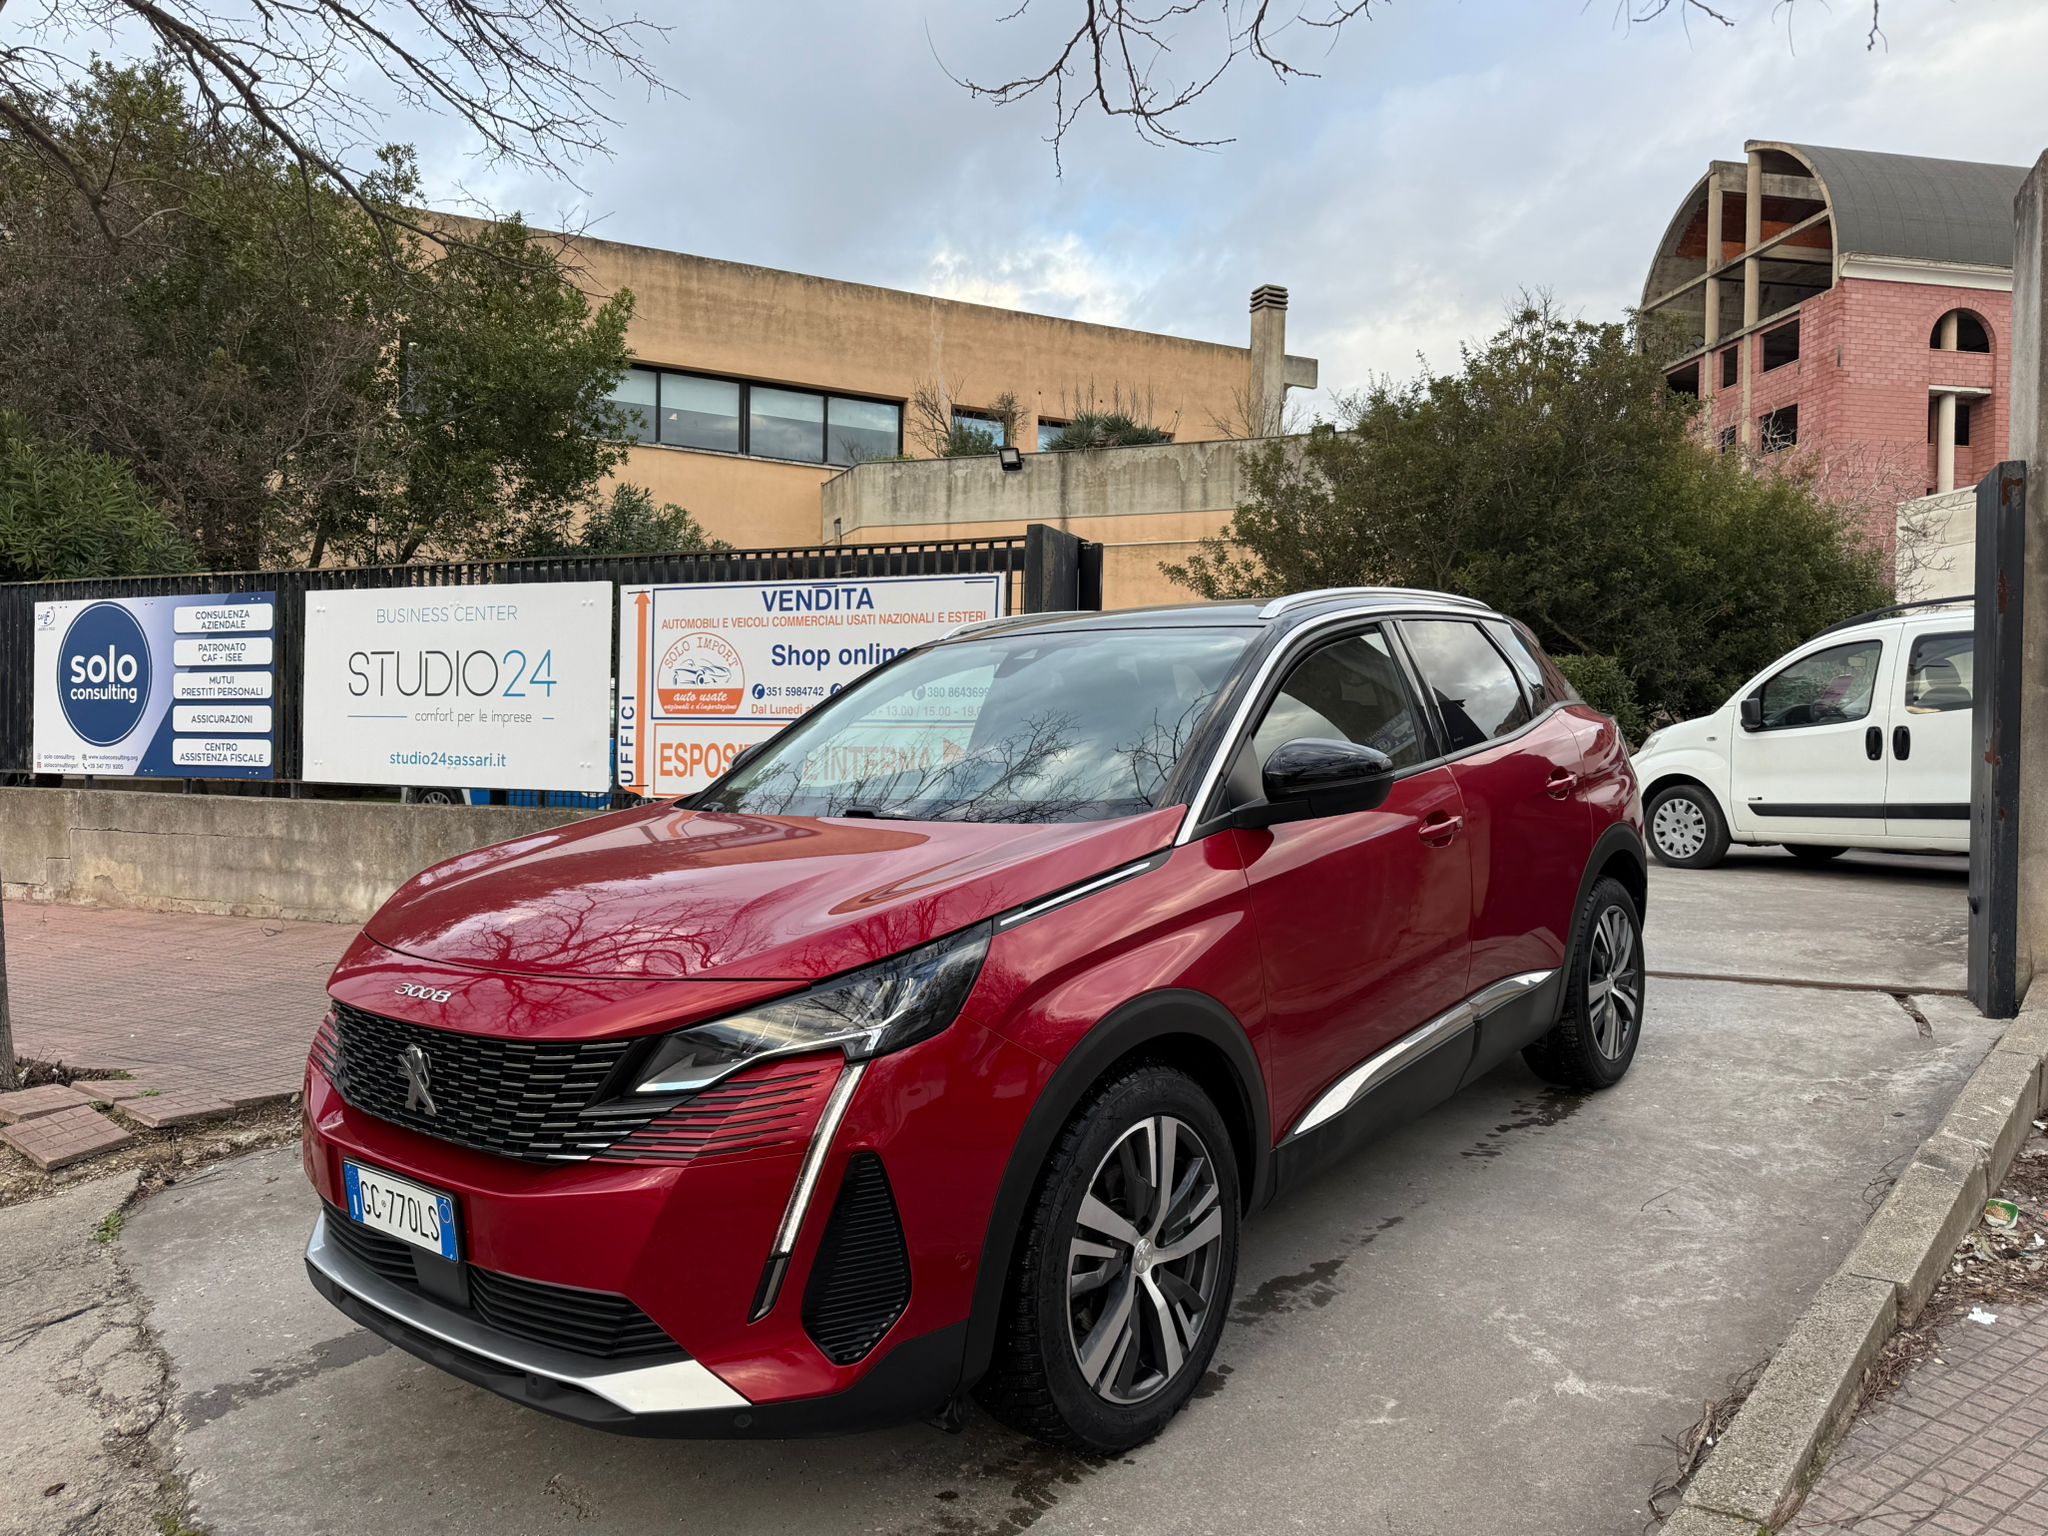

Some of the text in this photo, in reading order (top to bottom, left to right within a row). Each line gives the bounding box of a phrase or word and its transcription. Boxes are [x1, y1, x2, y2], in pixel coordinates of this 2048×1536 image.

[761, 587, 874, 612] VENDITA
[195, 609, 250, 620] CONSULENZA
[376, 604, 518, 624] BUSINESS CENTER
[661, 610, 986, 630] AUTOMOBILI E VEICOLI COMMERCIALI USATI NAZIONALI E ESTERI
[201, 620, 246, 630] AZIENDALE
[198, 643, 247, 653] PATRONATO
[664, 636, 738, 669] SOLO IMPORT
[201, 653, 218, 663] CAF
[225, 652, 243, 662] ISEE
[771, 643, 831, 671] Shop
[70, 644, 138, 683] solo
[348, 648, 557, 698] STUDIO24
[209, 675, 235, 685] MUTUI
[70, 683, 138, 704] consulting
[181, 687, 264, 697] PRESTITI PERSONALI
[673, 690, 728, 702] auto usate
[766, 686, 824, 697] 351 5984742
[927, 687, 945, 698] 380
[751, 703, 767, 715] Dal
[924, 706, 951, 717] 15.00
[191, 714, 253, 724] ASSICURAZIONI
[414, 707, 532, 728] comfort per le imprese
[620, 695, 635, 784] UFFICI
[204, 742, 238, 752] CENTRO
[180, 752, 264, 763] ASSISTENZA FISCALE
[389, 751, 507, 768] studio24sassari.it
[394, 982, 452, 1003] 3008
